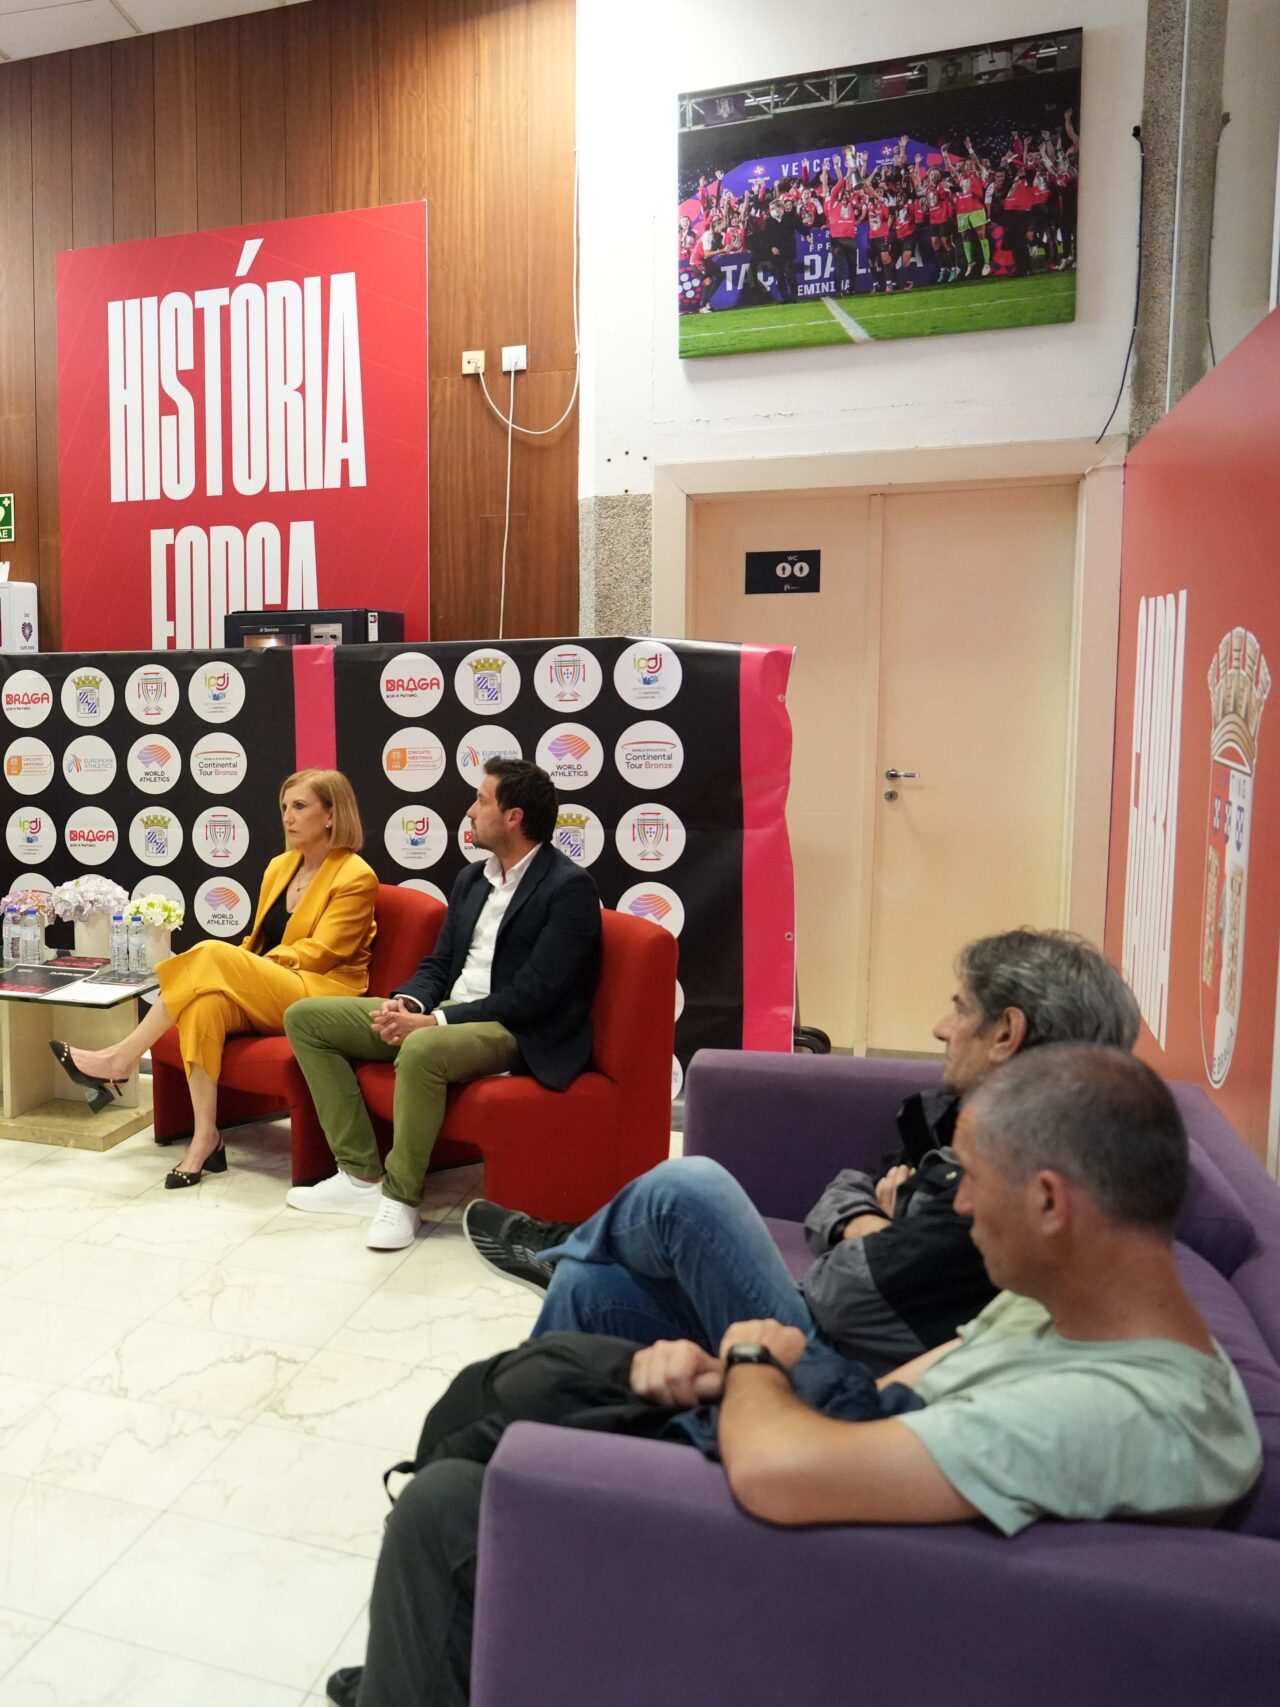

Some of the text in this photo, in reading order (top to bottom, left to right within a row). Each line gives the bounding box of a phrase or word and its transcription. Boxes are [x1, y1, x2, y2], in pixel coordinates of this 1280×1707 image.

[107, 238, 368, 503] HISTÓRIA
[385, 677, 441, 692] BRAGA
[5, 692, 50, 705] BRAGA
[625, 752, 673, 761] Continental
[198, 761, 238, 769] Continental
[644, 761, 673, 769] Bronze
[214, 768, 238, 776] Bronze
[69, 829, 115, 842] BRAGA
